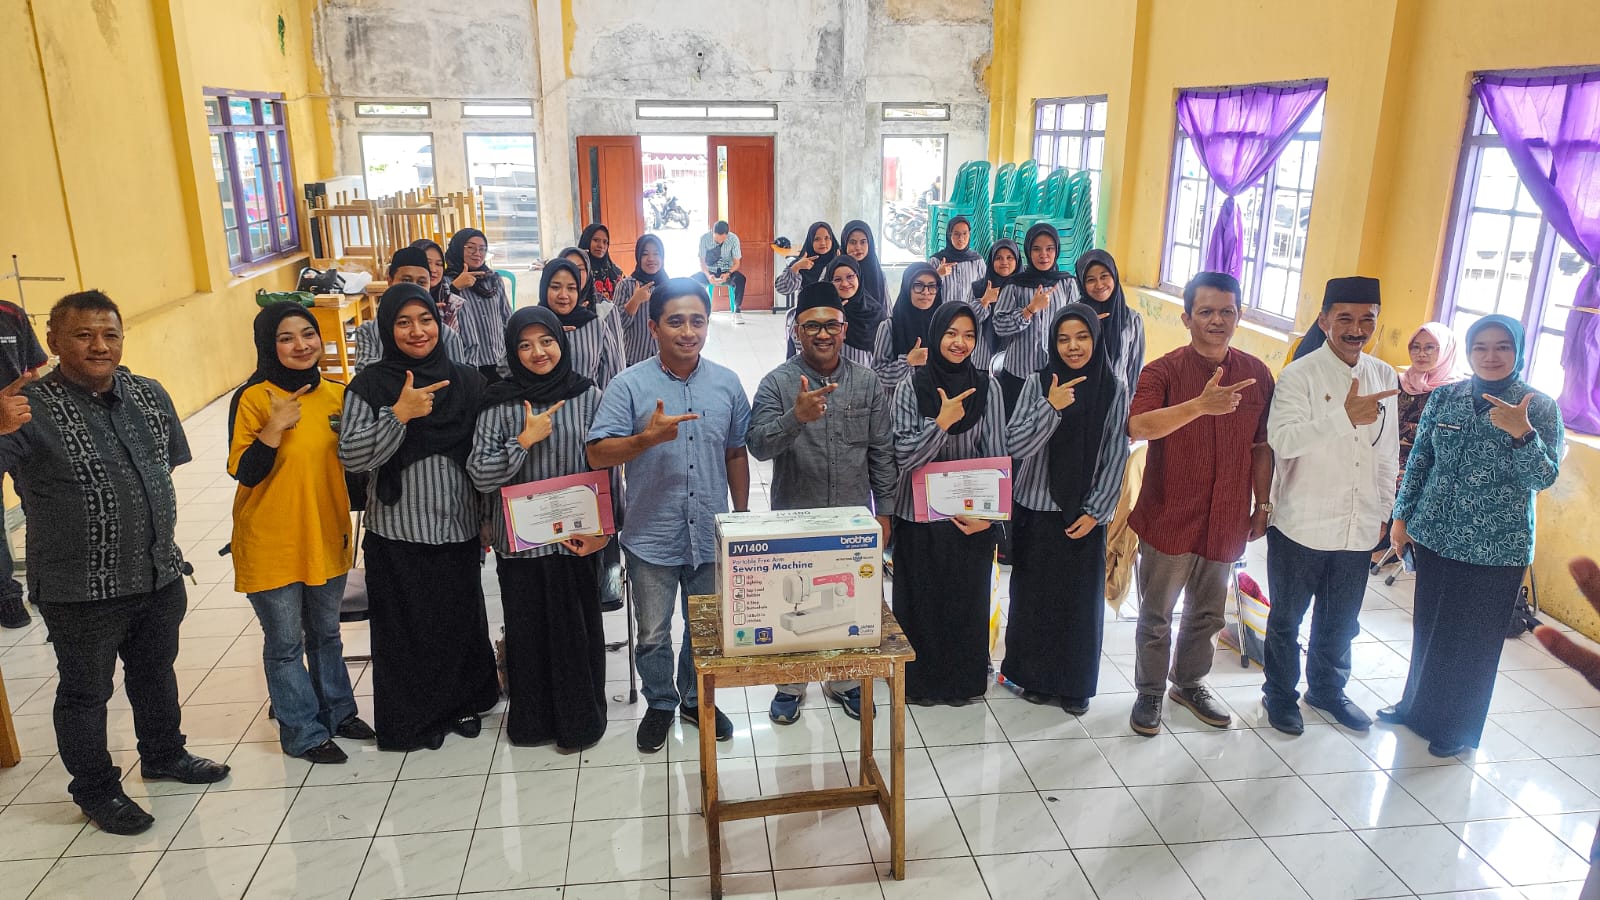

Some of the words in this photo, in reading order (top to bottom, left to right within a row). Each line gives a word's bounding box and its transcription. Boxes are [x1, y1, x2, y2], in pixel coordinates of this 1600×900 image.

[840, 536, 874, 545] brother
[733, 542, 769, 554] JV1400
[732, 563, 769, 573] Sewing
[772, 560, 814, 571] Machine
